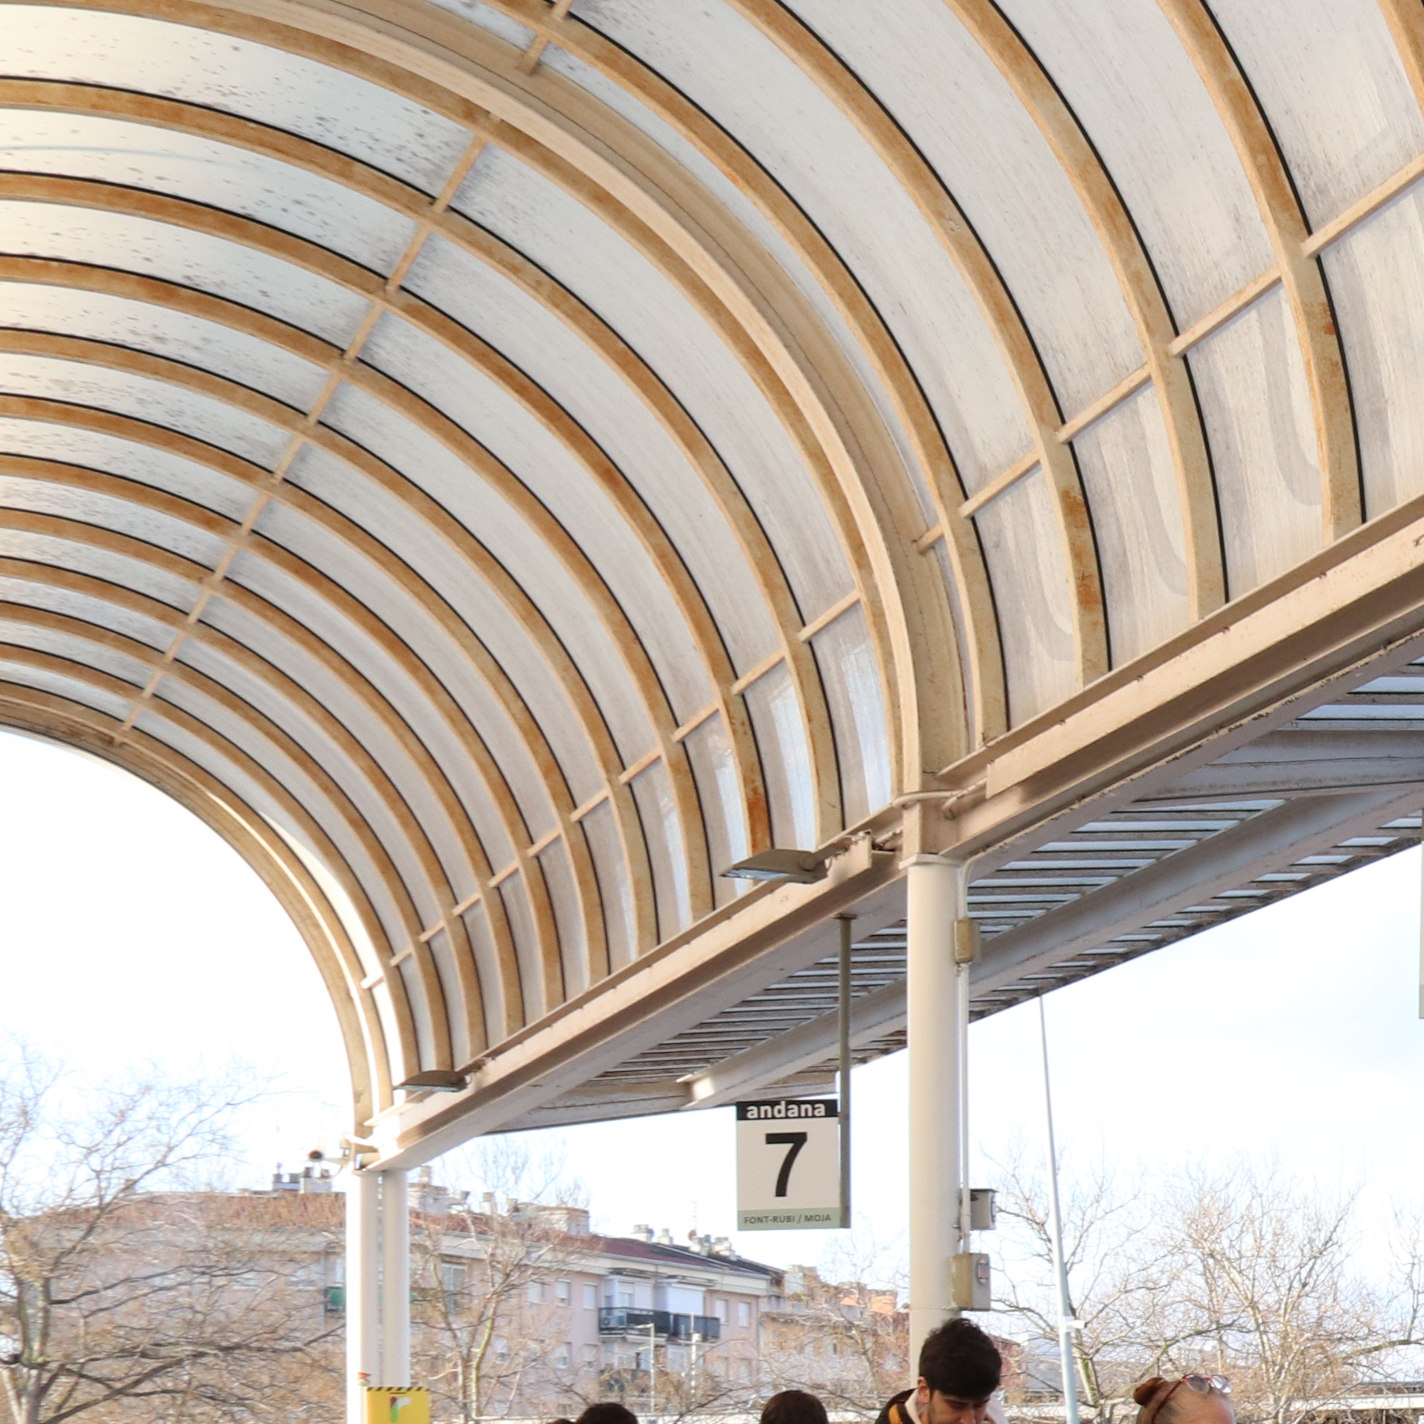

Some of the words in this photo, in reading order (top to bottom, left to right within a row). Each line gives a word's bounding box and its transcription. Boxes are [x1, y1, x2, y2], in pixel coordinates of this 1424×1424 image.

[746, 1100, 826, 1119] andana
[765, 1131, 808, 1198] 7
[804, 1213, 831, 1222] MOJA
